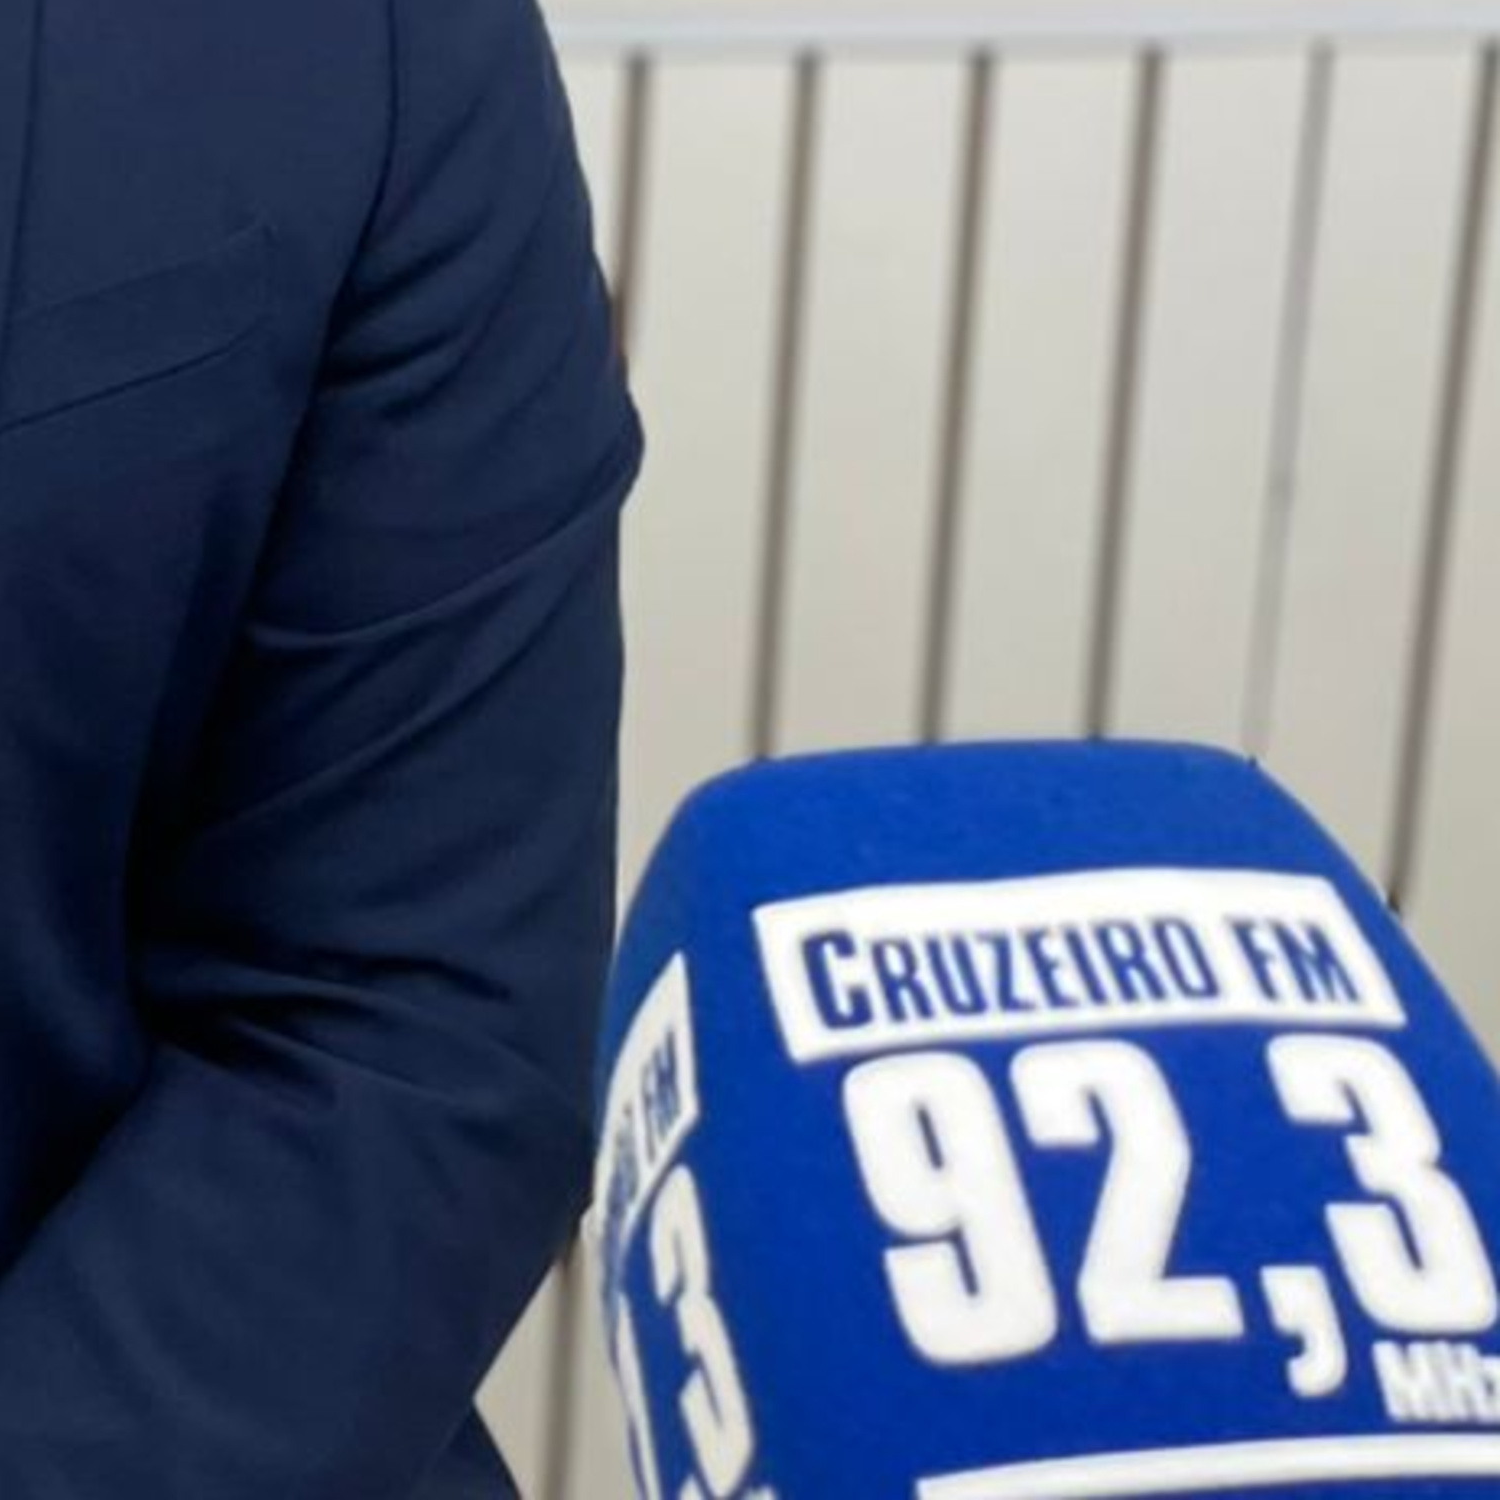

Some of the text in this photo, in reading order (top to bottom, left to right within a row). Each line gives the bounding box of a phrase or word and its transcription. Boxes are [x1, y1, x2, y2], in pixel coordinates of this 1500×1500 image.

[802, 916, 1359, 1030] CRUZEIRO FM
[842, 1035, 1499, 1397] 92,3
